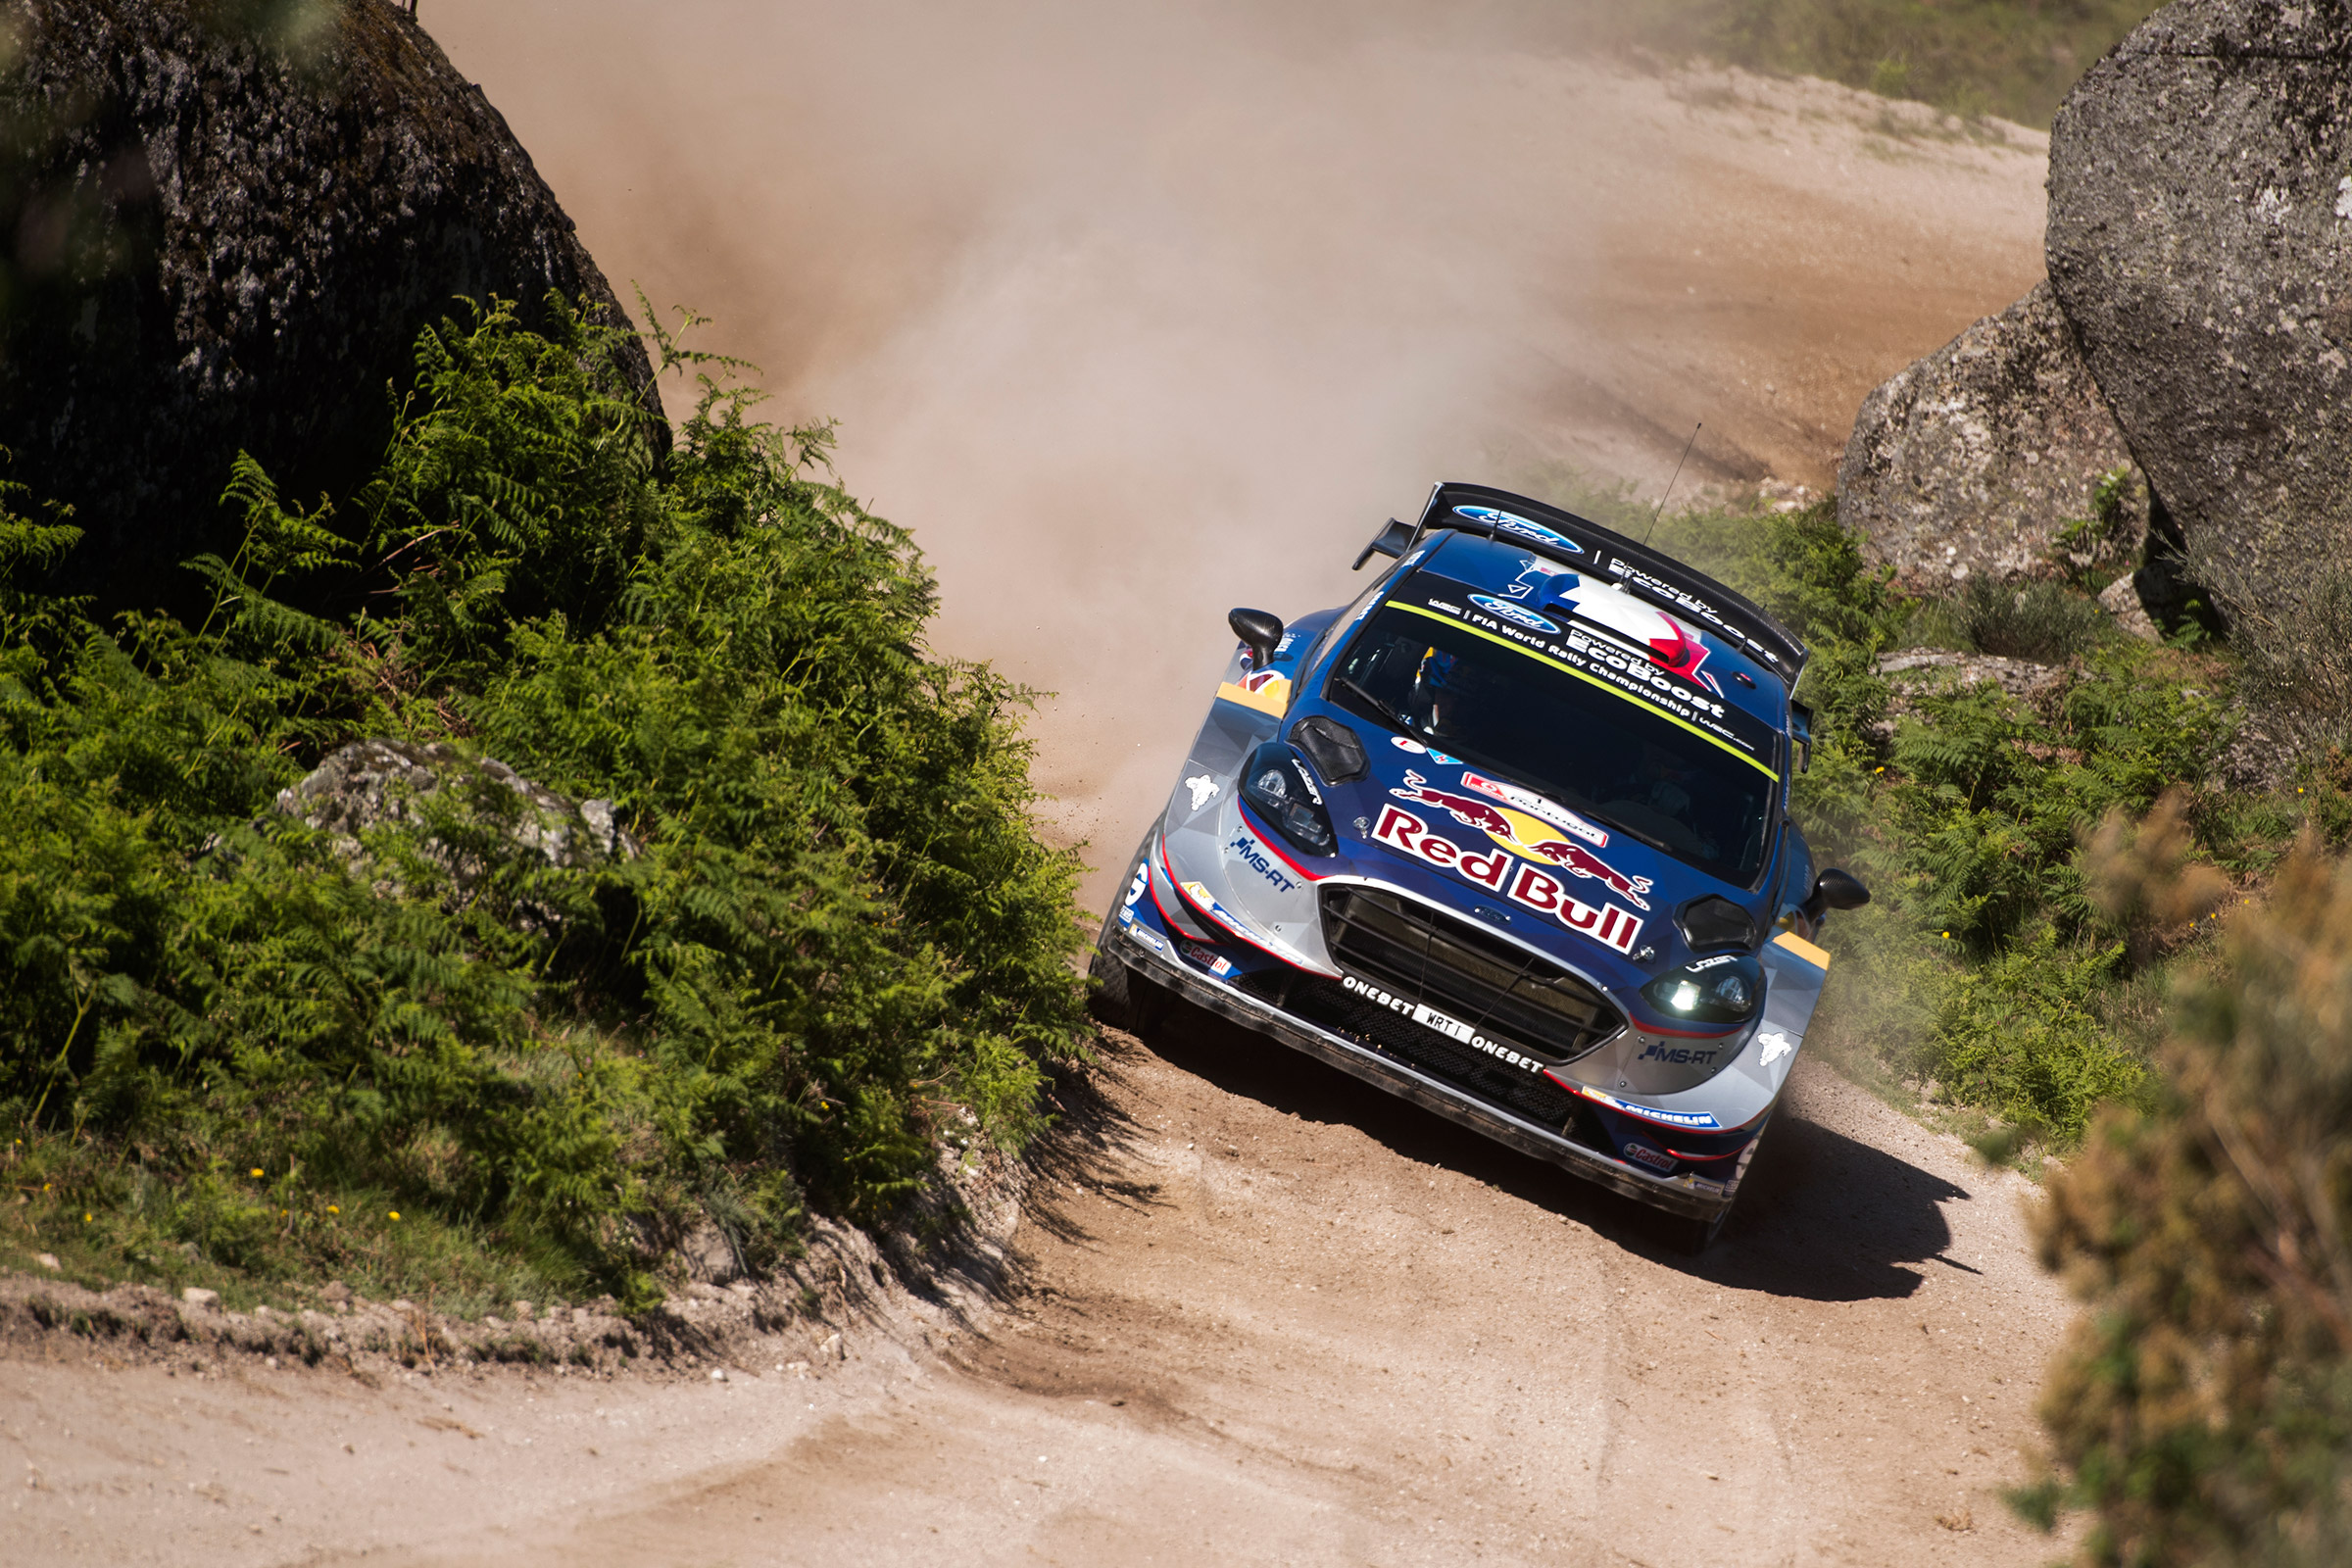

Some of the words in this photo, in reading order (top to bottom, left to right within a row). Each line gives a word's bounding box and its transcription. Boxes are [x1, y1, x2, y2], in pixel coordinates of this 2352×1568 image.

[1479, 512, 1560, 545] Ford
[1610, 557, 1693, 601] Powered
[1694, 599, 1718, 614] by
[1484, 600, 1544, 628] Ford
[1472, 613, 1498, 630] FIA
[1501, 624, 1545, 649] World
[1548, 645, 1587, 666] Rally
[1589, 662, 1690, 717] Championship
[1570, 628, 1642, 665] Powered
[1644, 662, 1665, 676] by
[1374, 804, 1512, 891] Red
[1509, 864, 1642, 954] Bull
[1190, 946, 1227, 971] Castrol
[1343, 976, 1415, 1016] ONEBET
[1426, 1011, 1453, 1032] WRT
[1471, 1036, 1544, 1074] ONEBET
[1625, 1104, 1713, 1126] MICHELIN
[1636, 1148, 1673, 1170] Castrol
